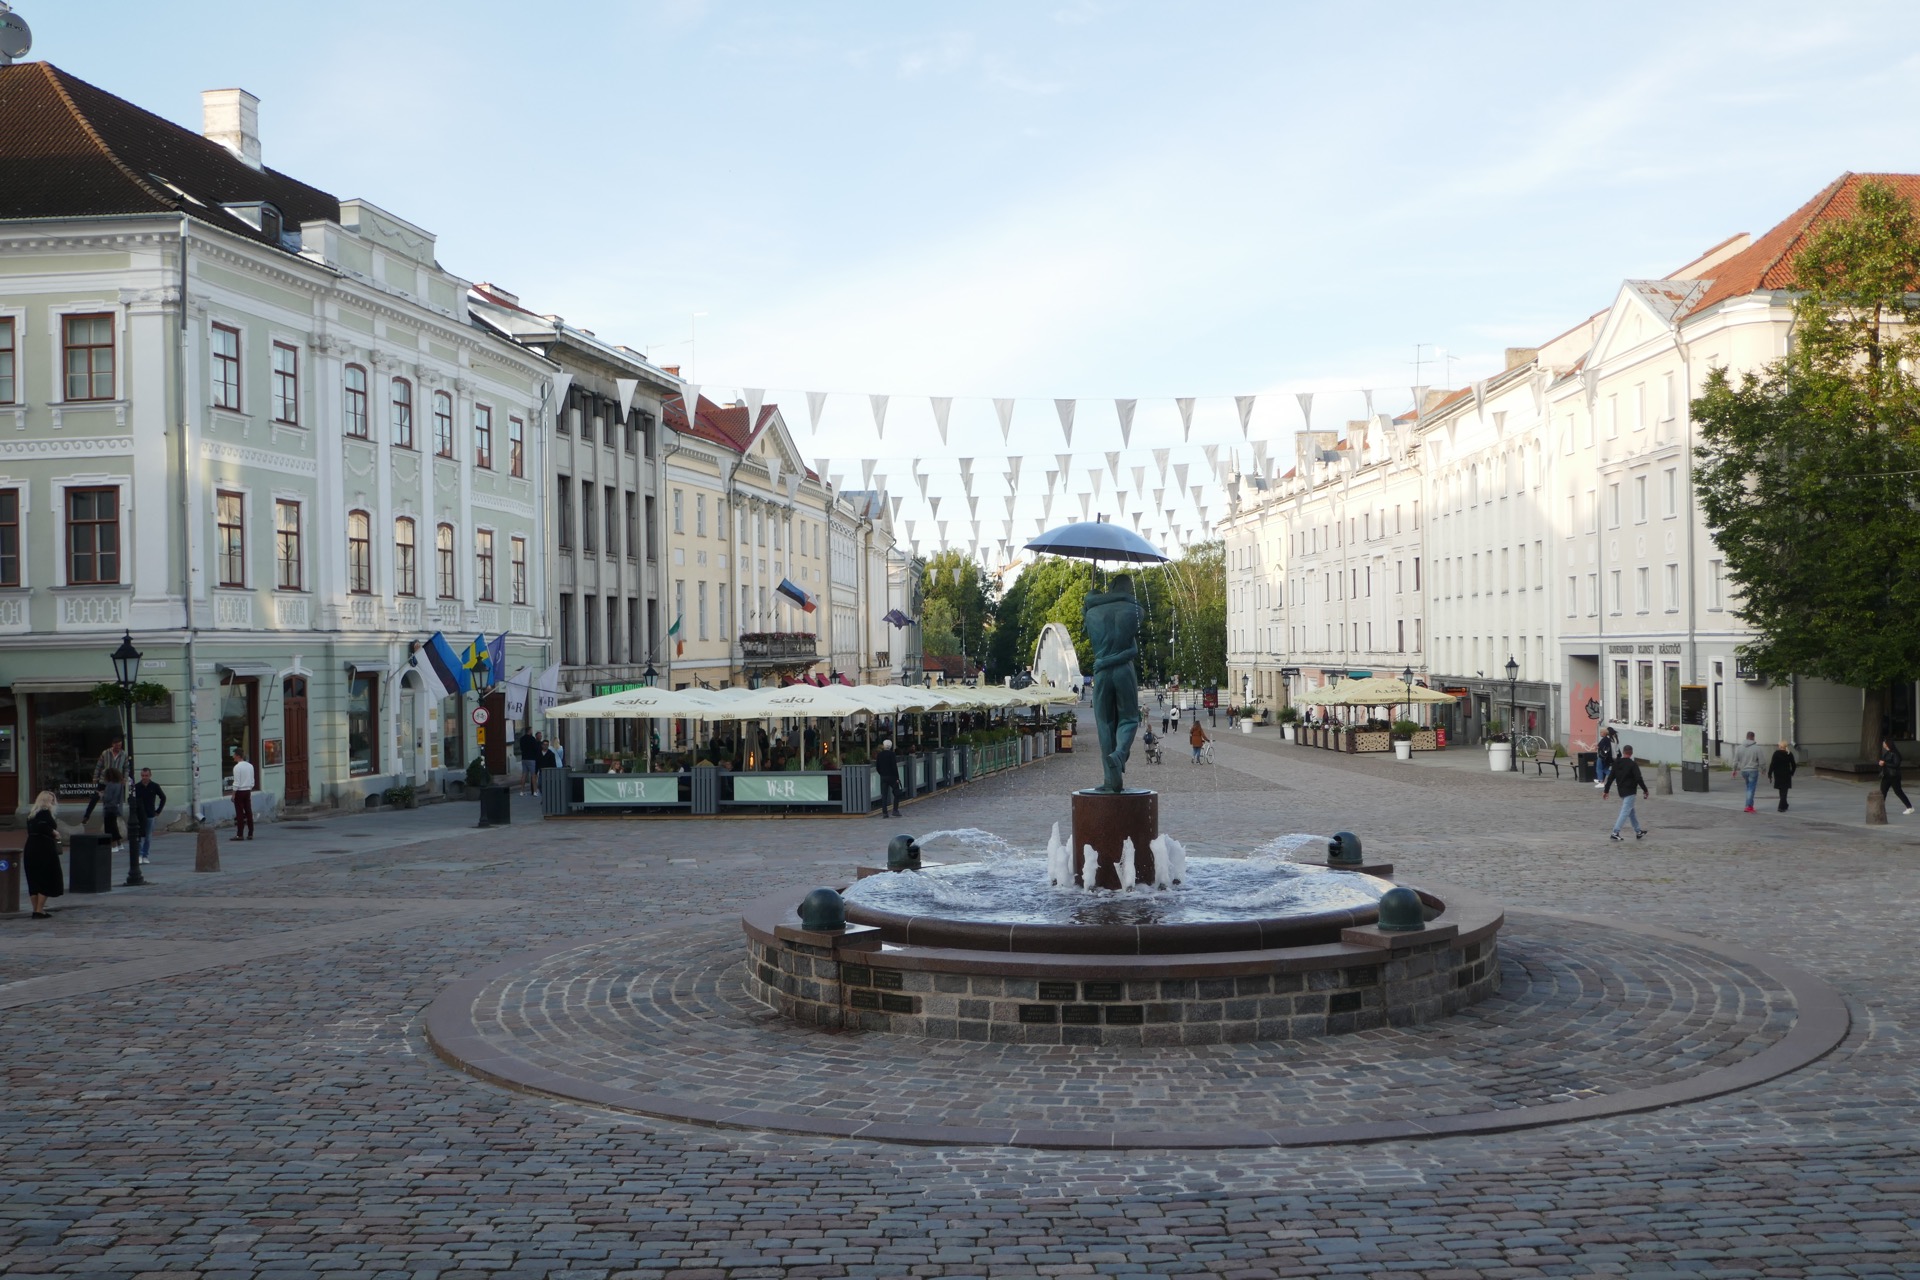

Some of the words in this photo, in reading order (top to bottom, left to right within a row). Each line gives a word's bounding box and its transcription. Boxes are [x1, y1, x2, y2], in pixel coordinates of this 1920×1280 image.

[767, 696, 815, 705] saku
[616, 781, 646, 798] W&R
[766, 779, 796, 797] W&R
